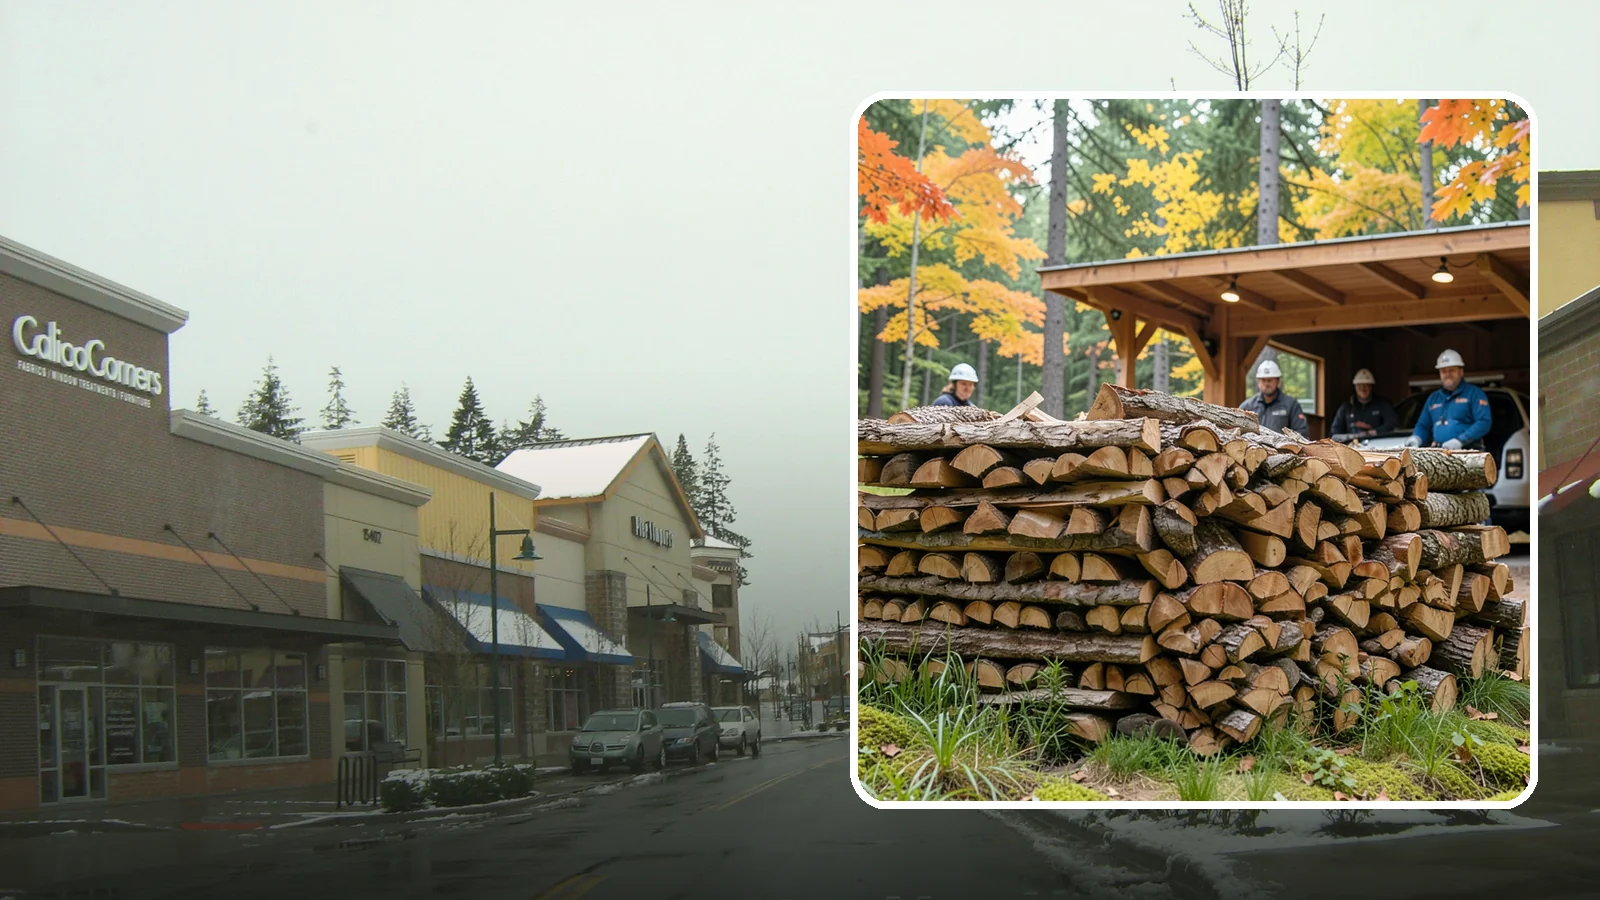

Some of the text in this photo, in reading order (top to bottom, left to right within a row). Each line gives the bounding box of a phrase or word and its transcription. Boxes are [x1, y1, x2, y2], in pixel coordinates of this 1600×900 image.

[17, 360, 47, 377] FABRICS
[51, 370, 78, 386] WINDOW
[79, 378, 117, 398] TREATMENTS
[120, 391, 151, 408] FURNITURE
